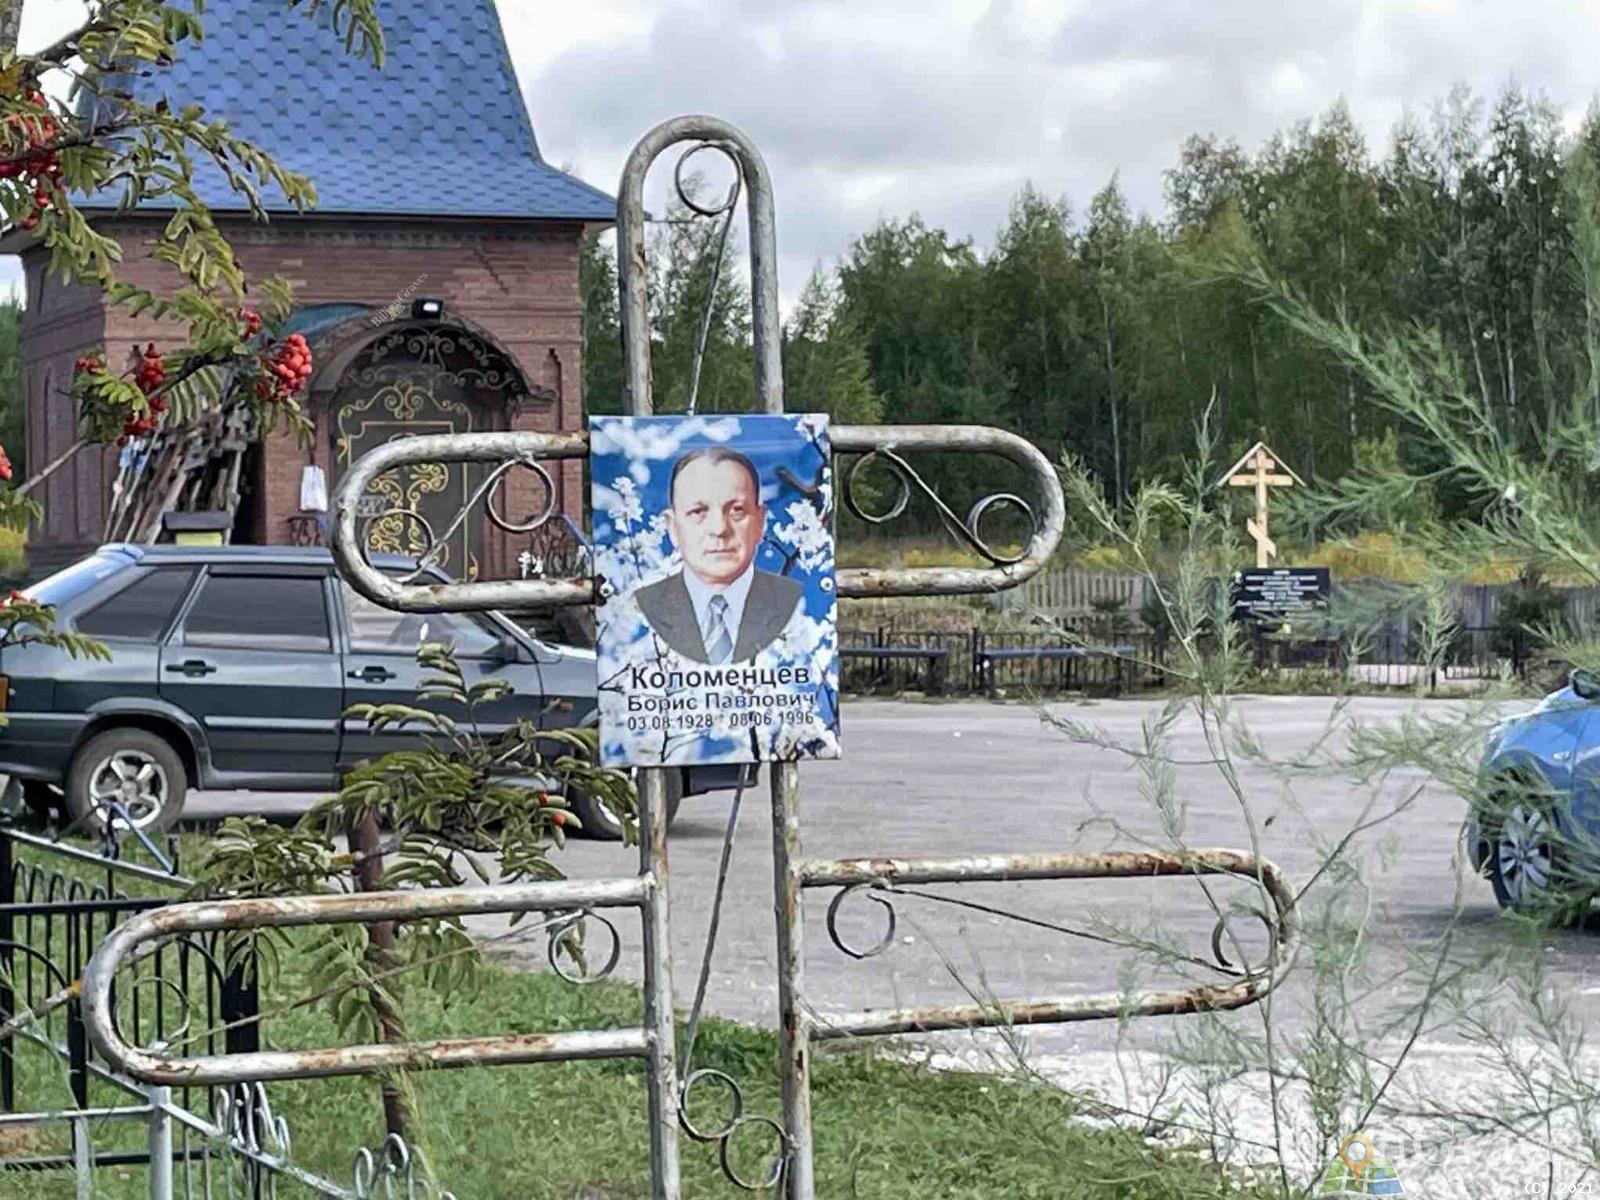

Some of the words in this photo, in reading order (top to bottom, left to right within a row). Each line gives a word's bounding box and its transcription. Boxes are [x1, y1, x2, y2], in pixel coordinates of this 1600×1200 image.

[632, 666, 810, 689] Коломенцев
[628, 695, 698, 714] Борис
[705, 692, 815, 710] Павлович
